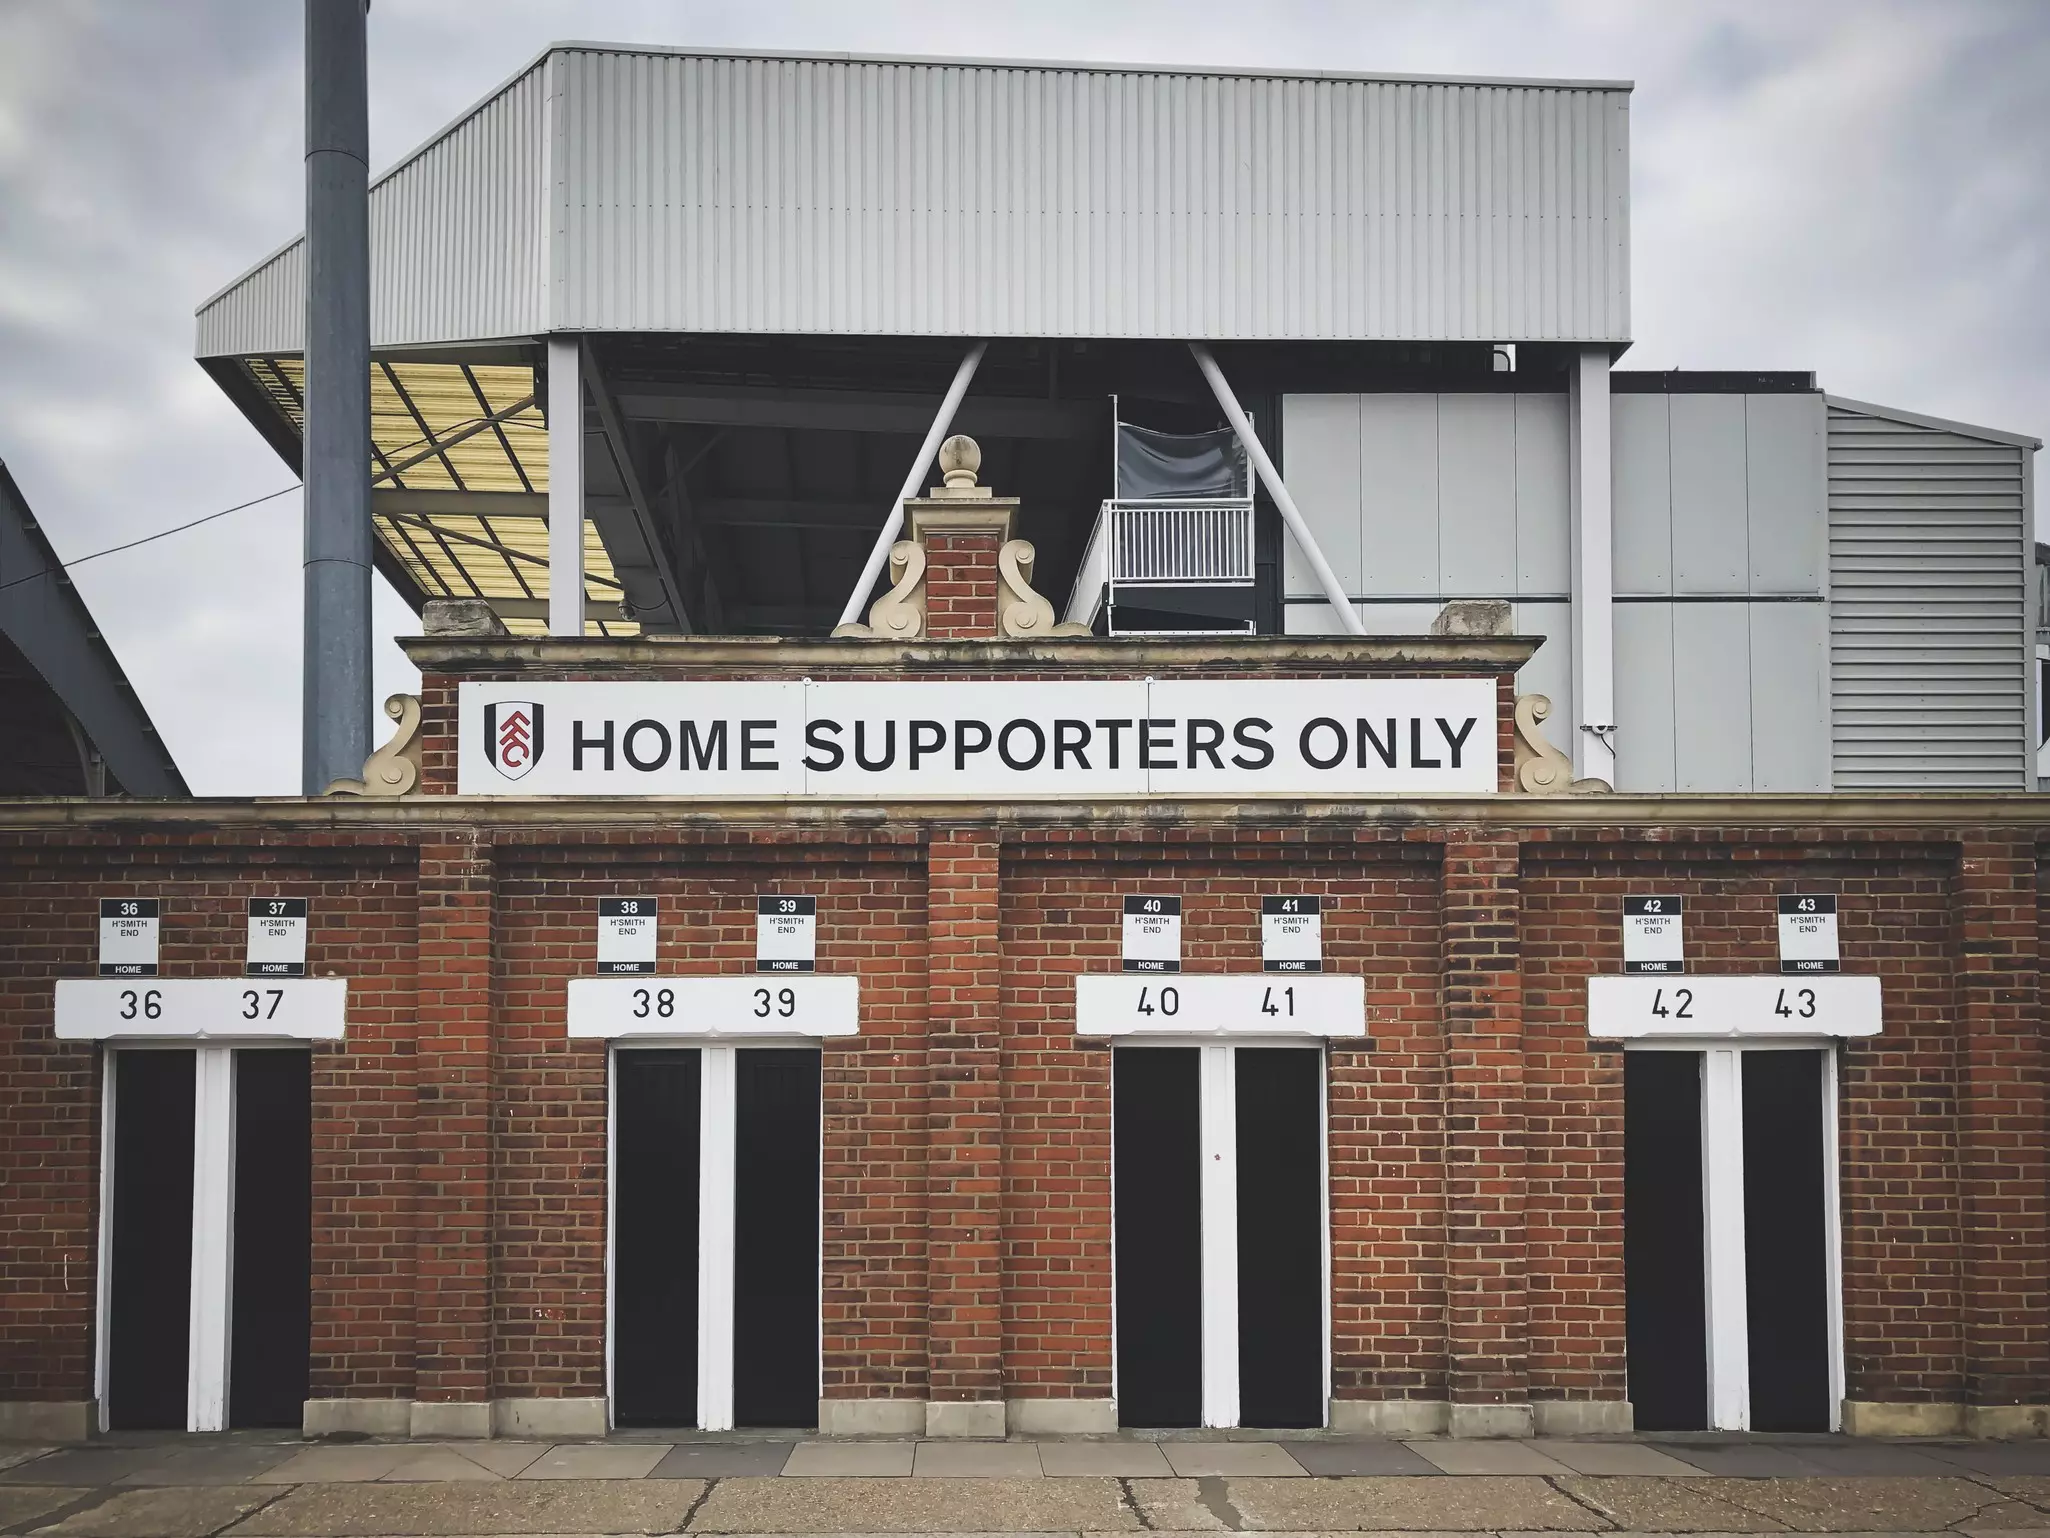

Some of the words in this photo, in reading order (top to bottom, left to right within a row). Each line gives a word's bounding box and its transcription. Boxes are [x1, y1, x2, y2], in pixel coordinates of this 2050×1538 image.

[499, 710, 531, 768] FFC
[573, 719, 779, 772] HOME
[805, 717, 1275, 772] SUPPORTERS
[1299, 717, 1477, 769] ONLY
[121, 903, 137, 915] 36
[269, 902, 286, 914] 37
[621, 902, 638, 913] 38
[780, 900, 796, 912] 39
[1144, 900, 1160, 912] 40
[1282, 900, 1298, 911] 41
[1644, 900, 1661, 912] 42
[1798, 899, 1815, 911] 43
[111, 919, 148, 928] H'SMITH
[260, 919, 296, 928] H'SMITH
[610, 918, 646, 927] H'SMITH
[769, 917, 805, 925] H'SMITH
[1134, 916, 1170, 925] H'SMITH
[1273, 916, 1309, 925] H'SMITH
[1635, 917, 1671, 926] H'SMITH
[1790, 916, 1826, 924] H'SMITH
[120, 929, 140, 937] END
[268, 928, 287, 937] END
[618, 927, 637, 936] END
[777, 926, 796, 934] END
[1143, 925, 1162, 934] END
[1282, 925, 1301, 934] END
[1643, 926, 1663, 935] END
[1799, 925, 1818, 933] END
[772, 962, 798, 970] HOME
[1797, 961, 1823, 969] HOME
[120, 990, 161, 1019] 36
[243, 990, 283, 1019] 37
[633, 989, 674, 1018] 38
[754, 988, 794, 1017] 39
[1138, 987, 1178, 1016] 40
[1262, 987, 1293, 1016] 41
[1652, 989, 1692, 1018] 42
[1775, 989, 1815, 1018] 43
